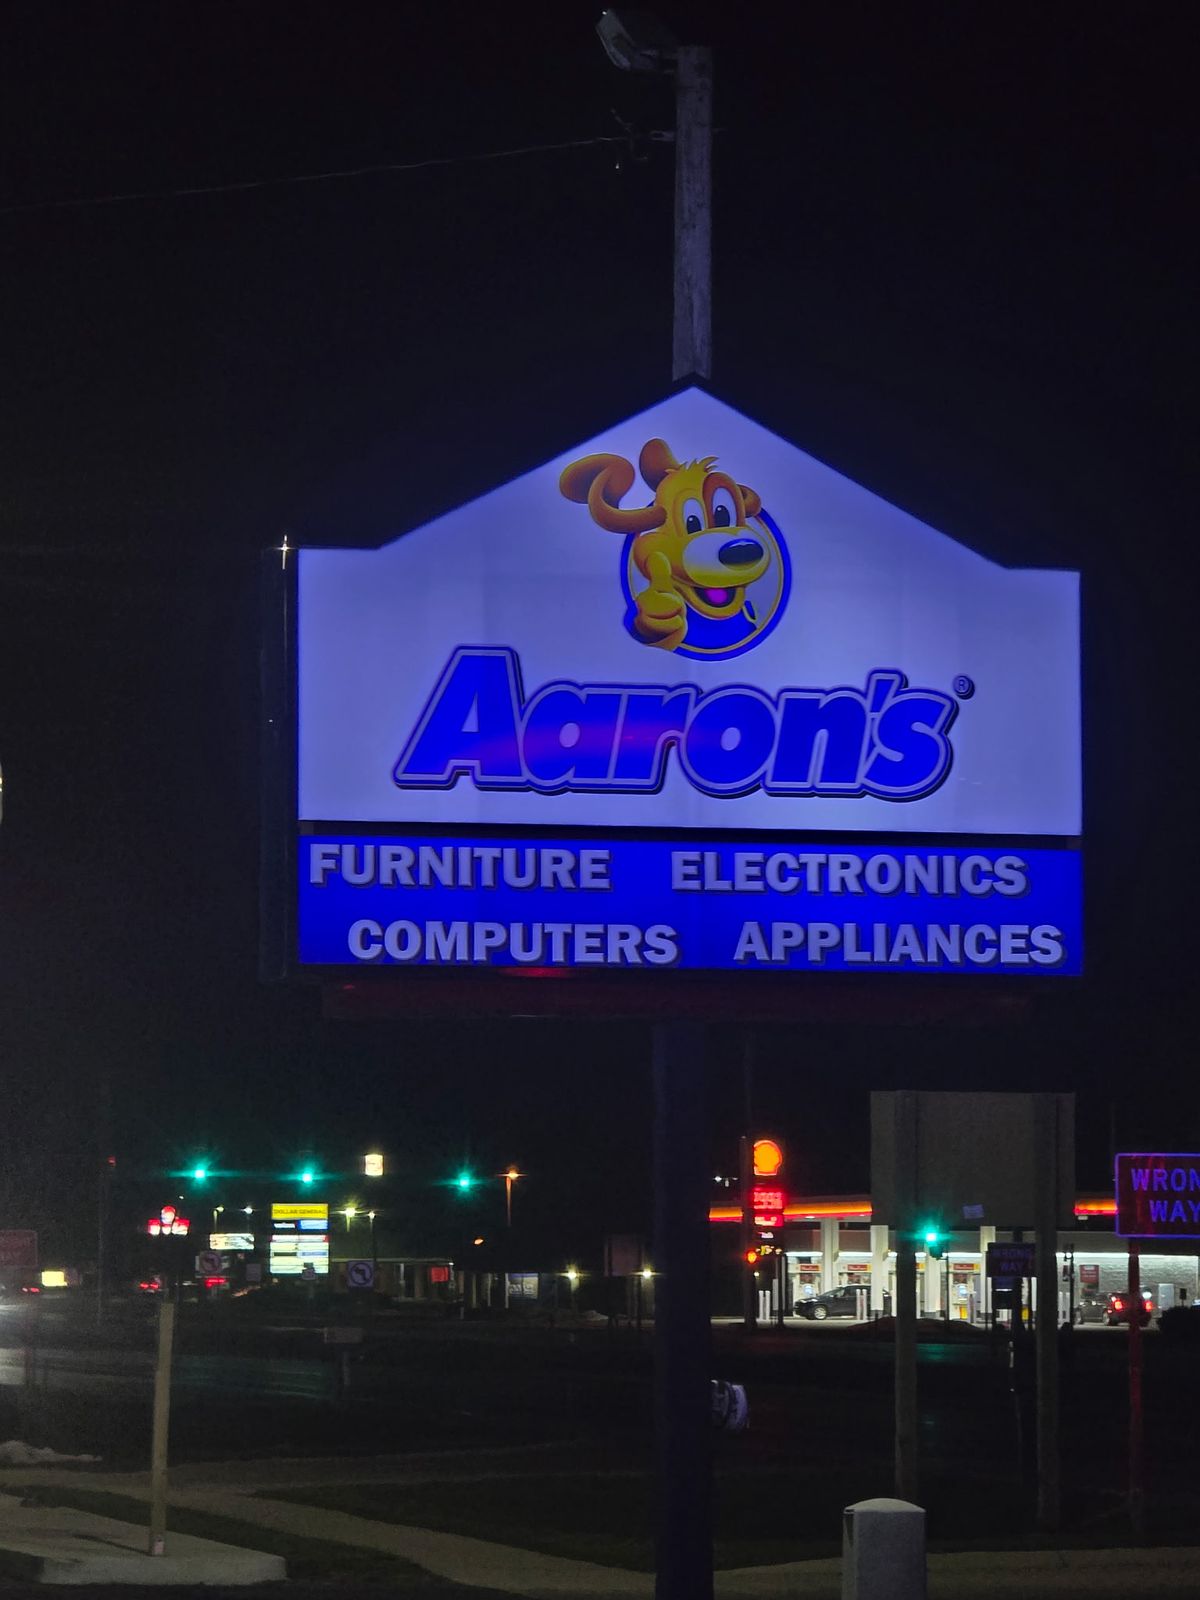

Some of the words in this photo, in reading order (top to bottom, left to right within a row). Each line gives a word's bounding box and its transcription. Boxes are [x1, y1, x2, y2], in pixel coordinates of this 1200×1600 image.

[394, 645, 959, 803] Aaron's
[309, 843, 612, 889] FURNITURE
[670, 850, 1028, 896] ELECTRONICS
[347, 918, 680, 965] COMPUTERS
[733, 921, 1064, 965] APPLIANCES
[1149, 1200, 1200, 1222] WAY
